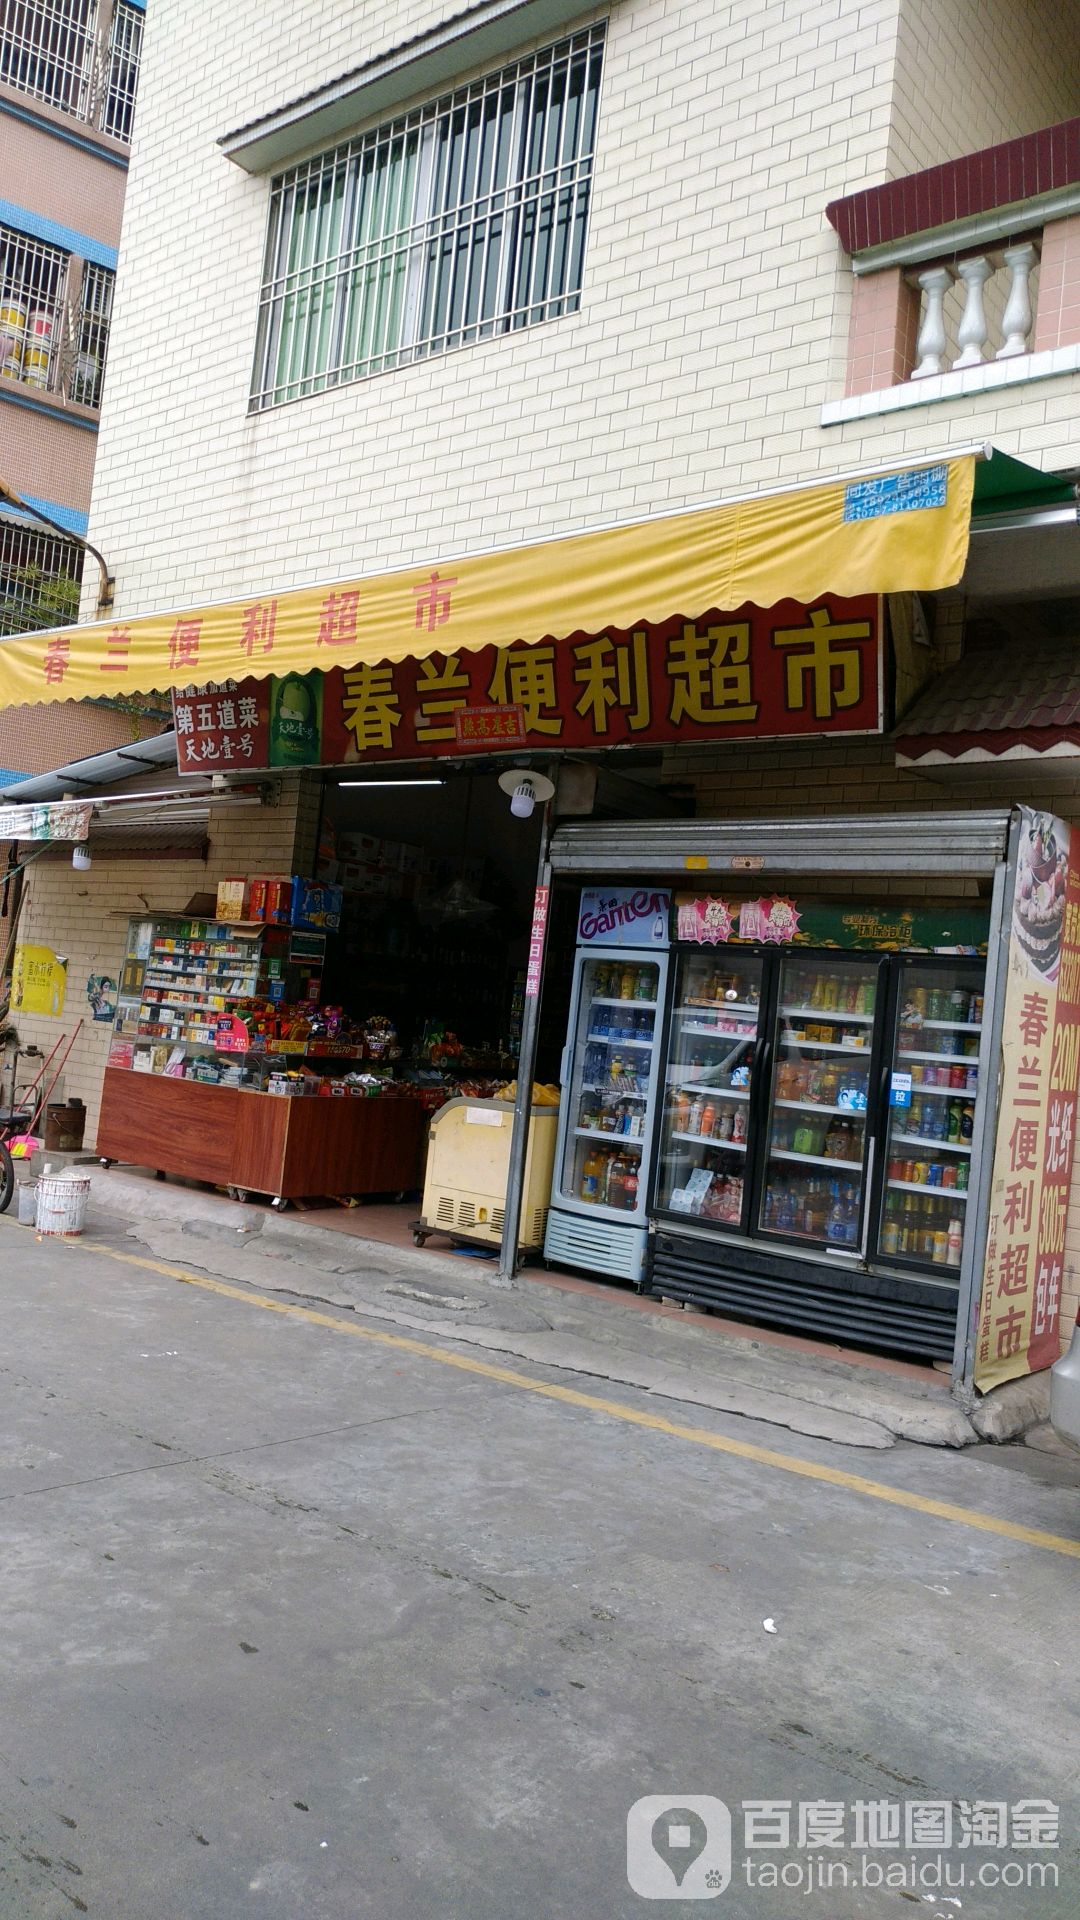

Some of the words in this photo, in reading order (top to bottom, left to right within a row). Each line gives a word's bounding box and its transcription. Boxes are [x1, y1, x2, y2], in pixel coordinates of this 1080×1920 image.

[43, 571, 458, 685] 春兰便利超市
[176, 697, 259, 735] 第五道菜
[343, 608, 872, 751] 春兰便利超市
[185, 733, 255, 763] 天地壹号
[525, 889, 549, 995] 订做生日蛋糕
[579, 890, 670, 940] Ganten
[1051, 1022, 1080, 1092] 20M
[1045, 1099, 1074, 1174] 光纤
[995, 992, 1049, 1361] 春兰便利超市
[1038, 1185, 1067, 1256] 300元
[1034, 1260, 1061, 1335] 包年
